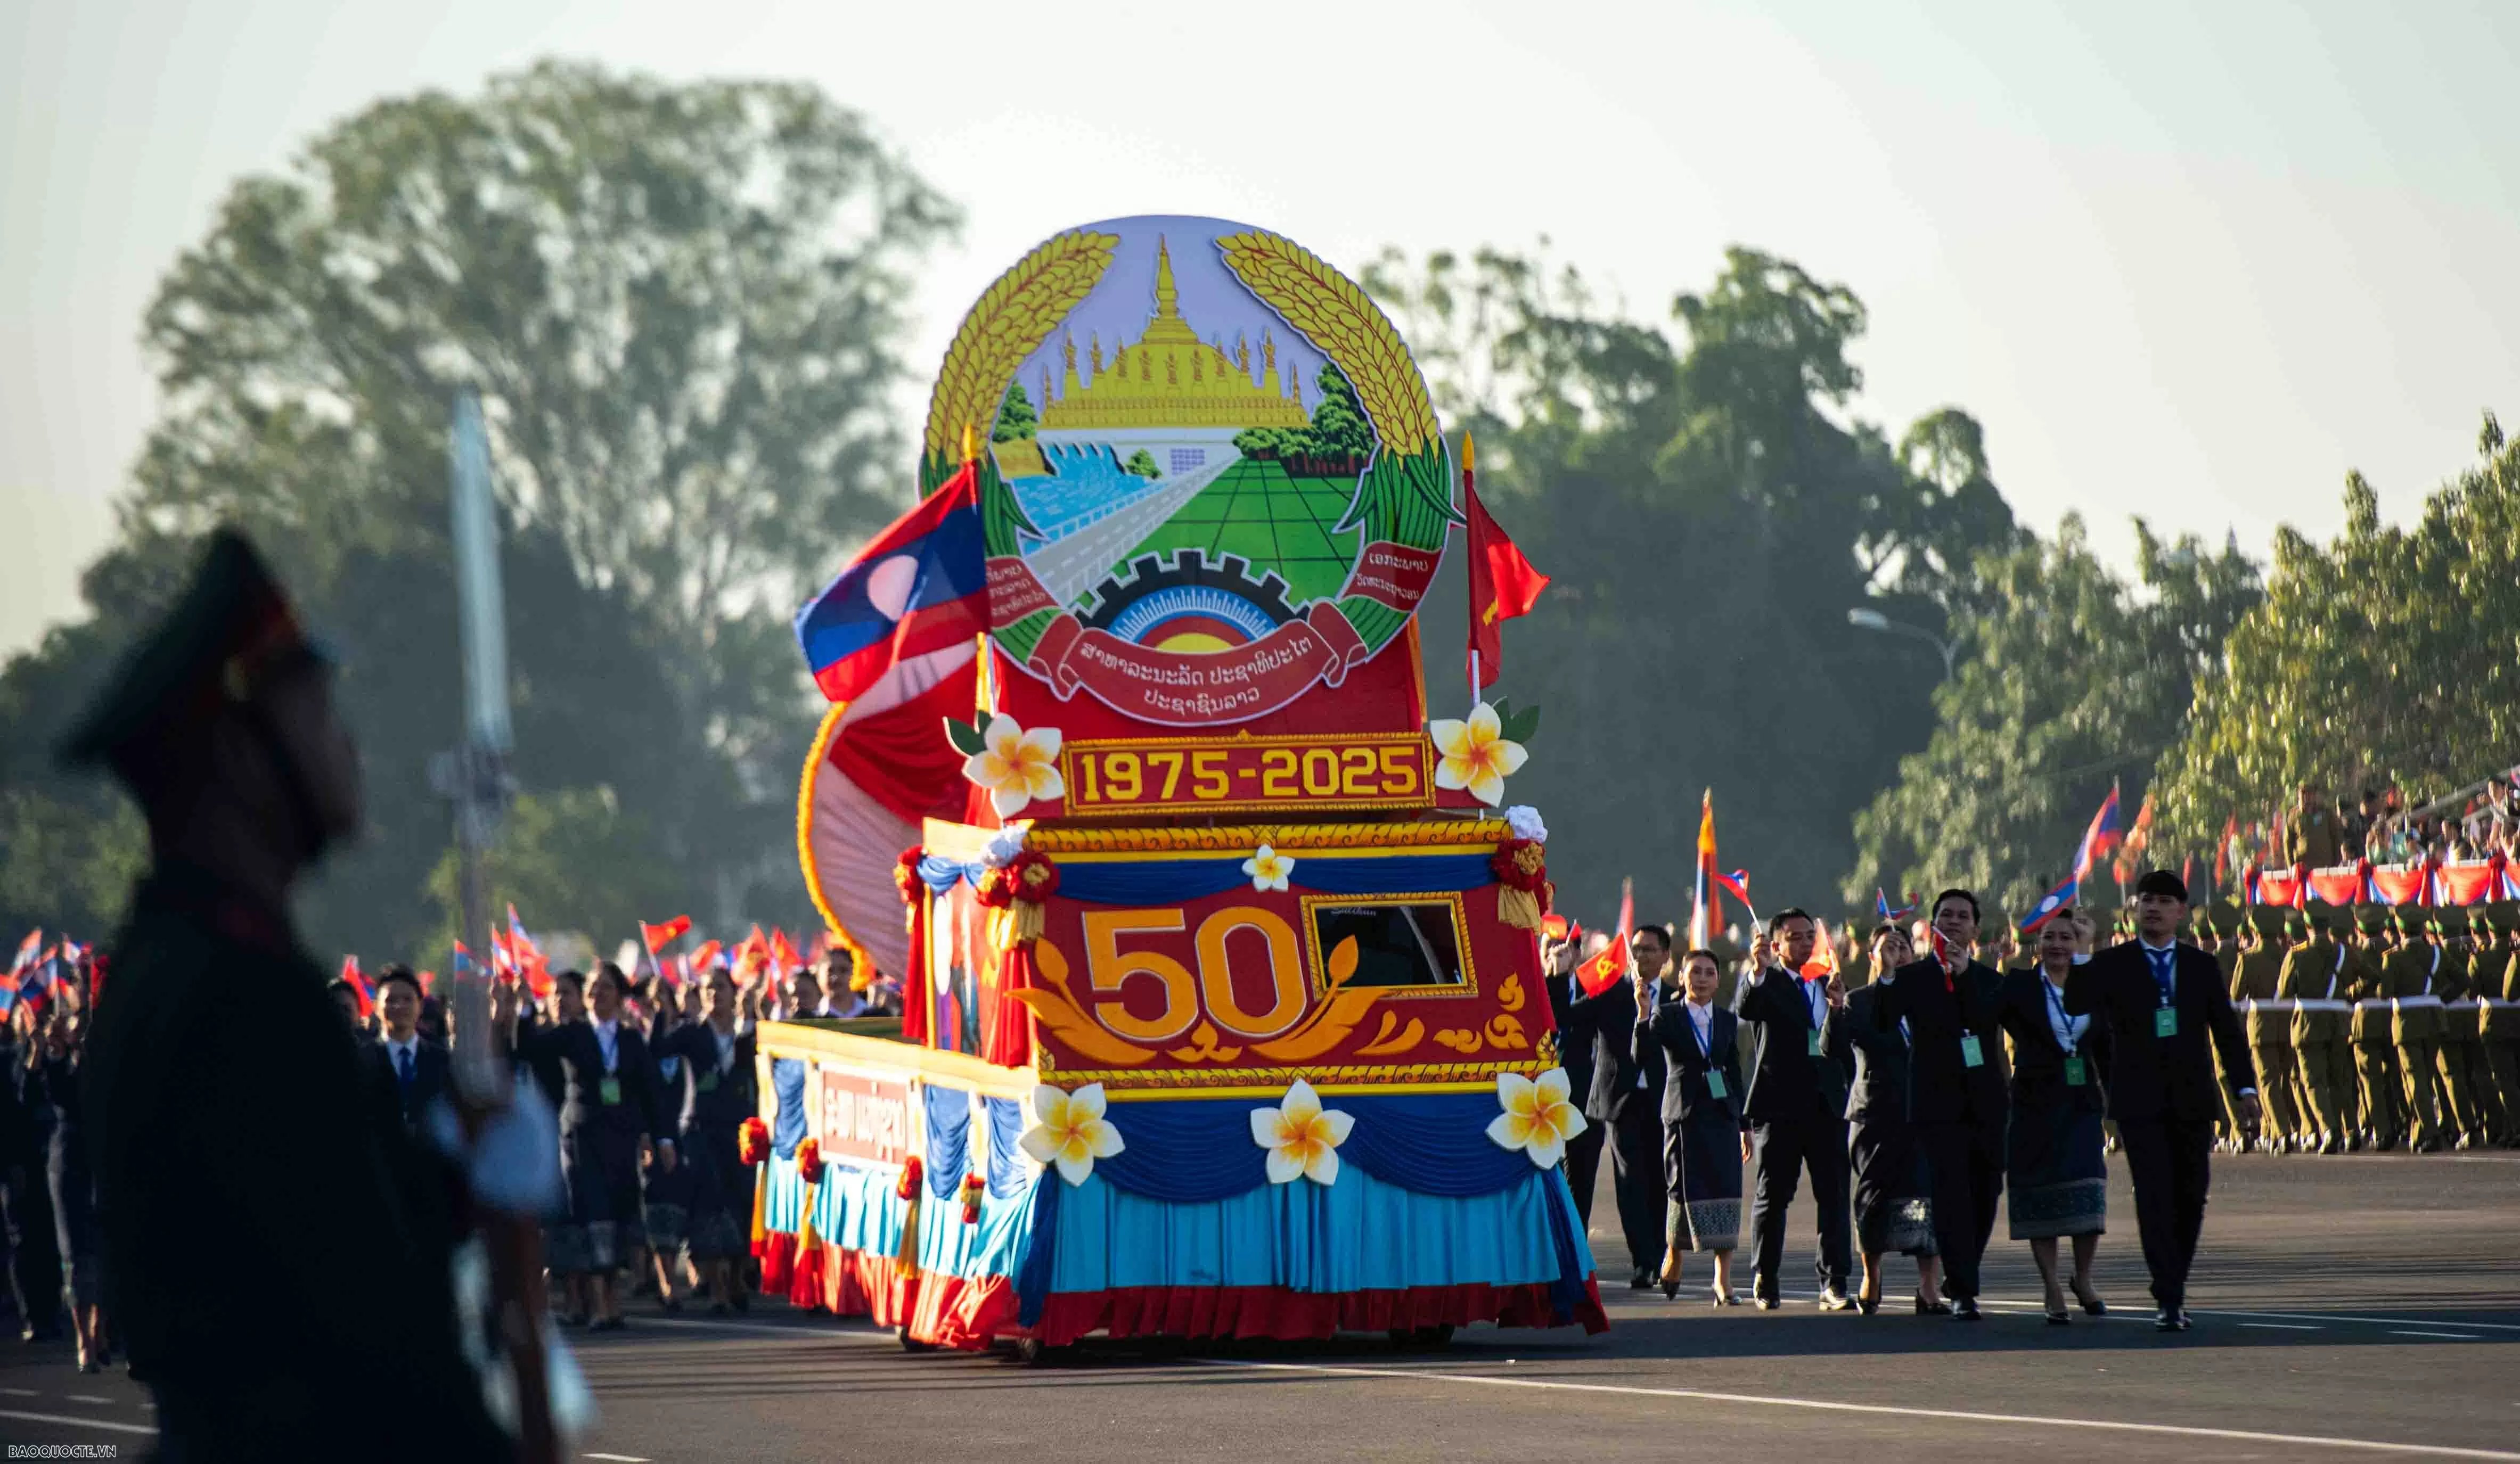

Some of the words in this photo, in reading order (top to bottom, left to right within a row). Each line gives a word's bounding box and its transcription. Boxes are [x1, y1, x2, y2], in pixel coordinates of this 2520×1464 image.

[1080, 643, 1204, 686] ສາທາລະນະລັດ
[1209, 636, 1313, 685] ປະຊາທິປະໄຕ
[1144, 687, 1259, 716] ປະຊາຊົນລາວ
[1081, 746, 1418, 802] 1975-2025
[1082, 906, 1307, 1042] 50
